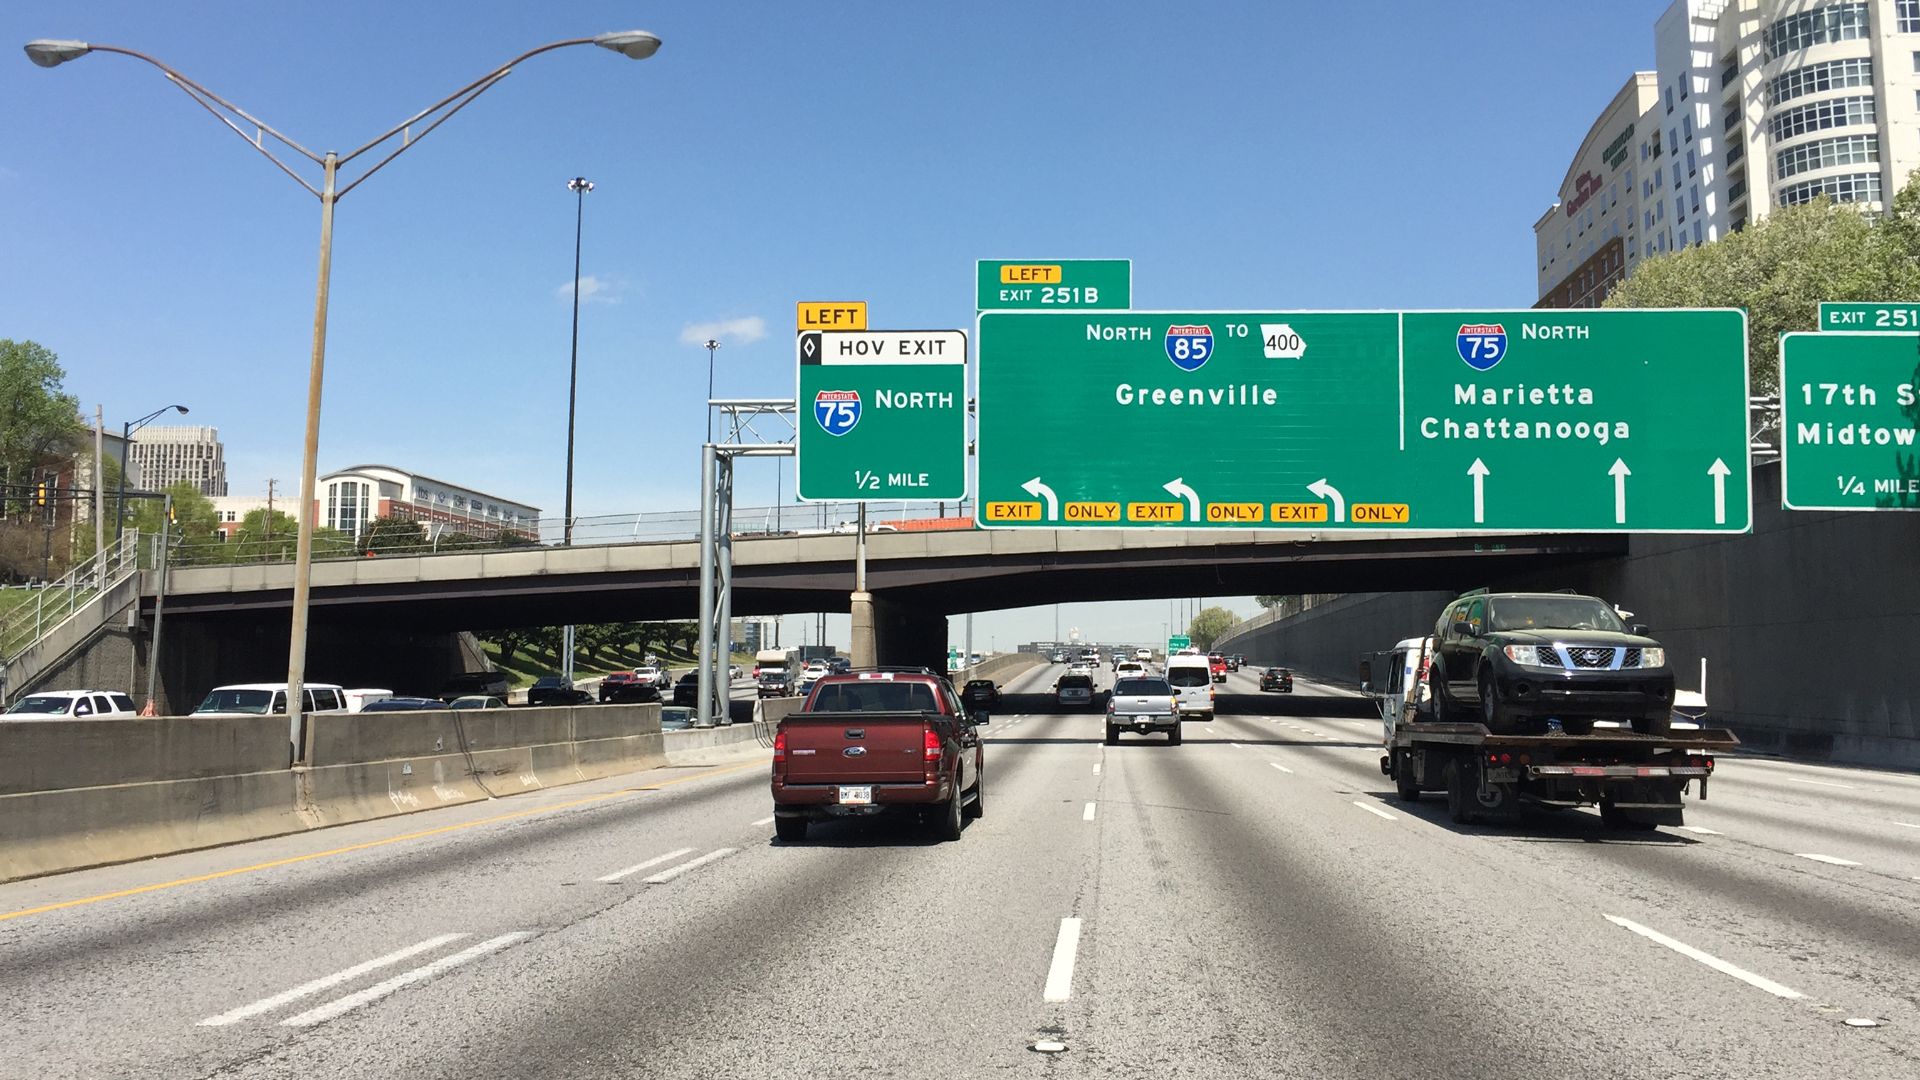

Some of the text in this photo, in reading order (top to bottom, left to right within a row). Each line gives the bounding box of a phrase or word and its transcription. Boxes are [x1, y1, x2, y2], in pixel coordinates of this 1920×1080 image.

[1010, 269, 1052, 281] LEFT
[999, 286, 1099, 304] EXIT 251B
[805, 309, 858, 325] LEFT
[1829, 309, 1918, 327] EXIT 251
[1086, 324, 1152, 341] NORTH
[1225, 323, 1249, 338] TO
[1522, 323, 1589, 340] NORTH
[840, 340, 946, 356] HOV EXIT
[1174, 338, 1207, 360] 85
[1266, 334, 1300, 351] 400
[1466, 337, 1500, 359] 75
[875, 389, 953, 409] NORTH
[1115, 383, 1277, 406] Greenville
[1454, 383, 1593, 405] Marietta
[1801, 383, 1920, 406] 17th S
[819, 402, 856, 427] 75
[1420, 417, 1630, 448] Chattanooga
[888, 473, 929, 487] MILE
[1874, 479, 1920, 493] MILE
[994, 504, 1116, 518] EXIT ONLY
[1135, 505, 1259, 519] EXIT ONLY
[1279, 506, 1405, 520] EXIT ONLY
